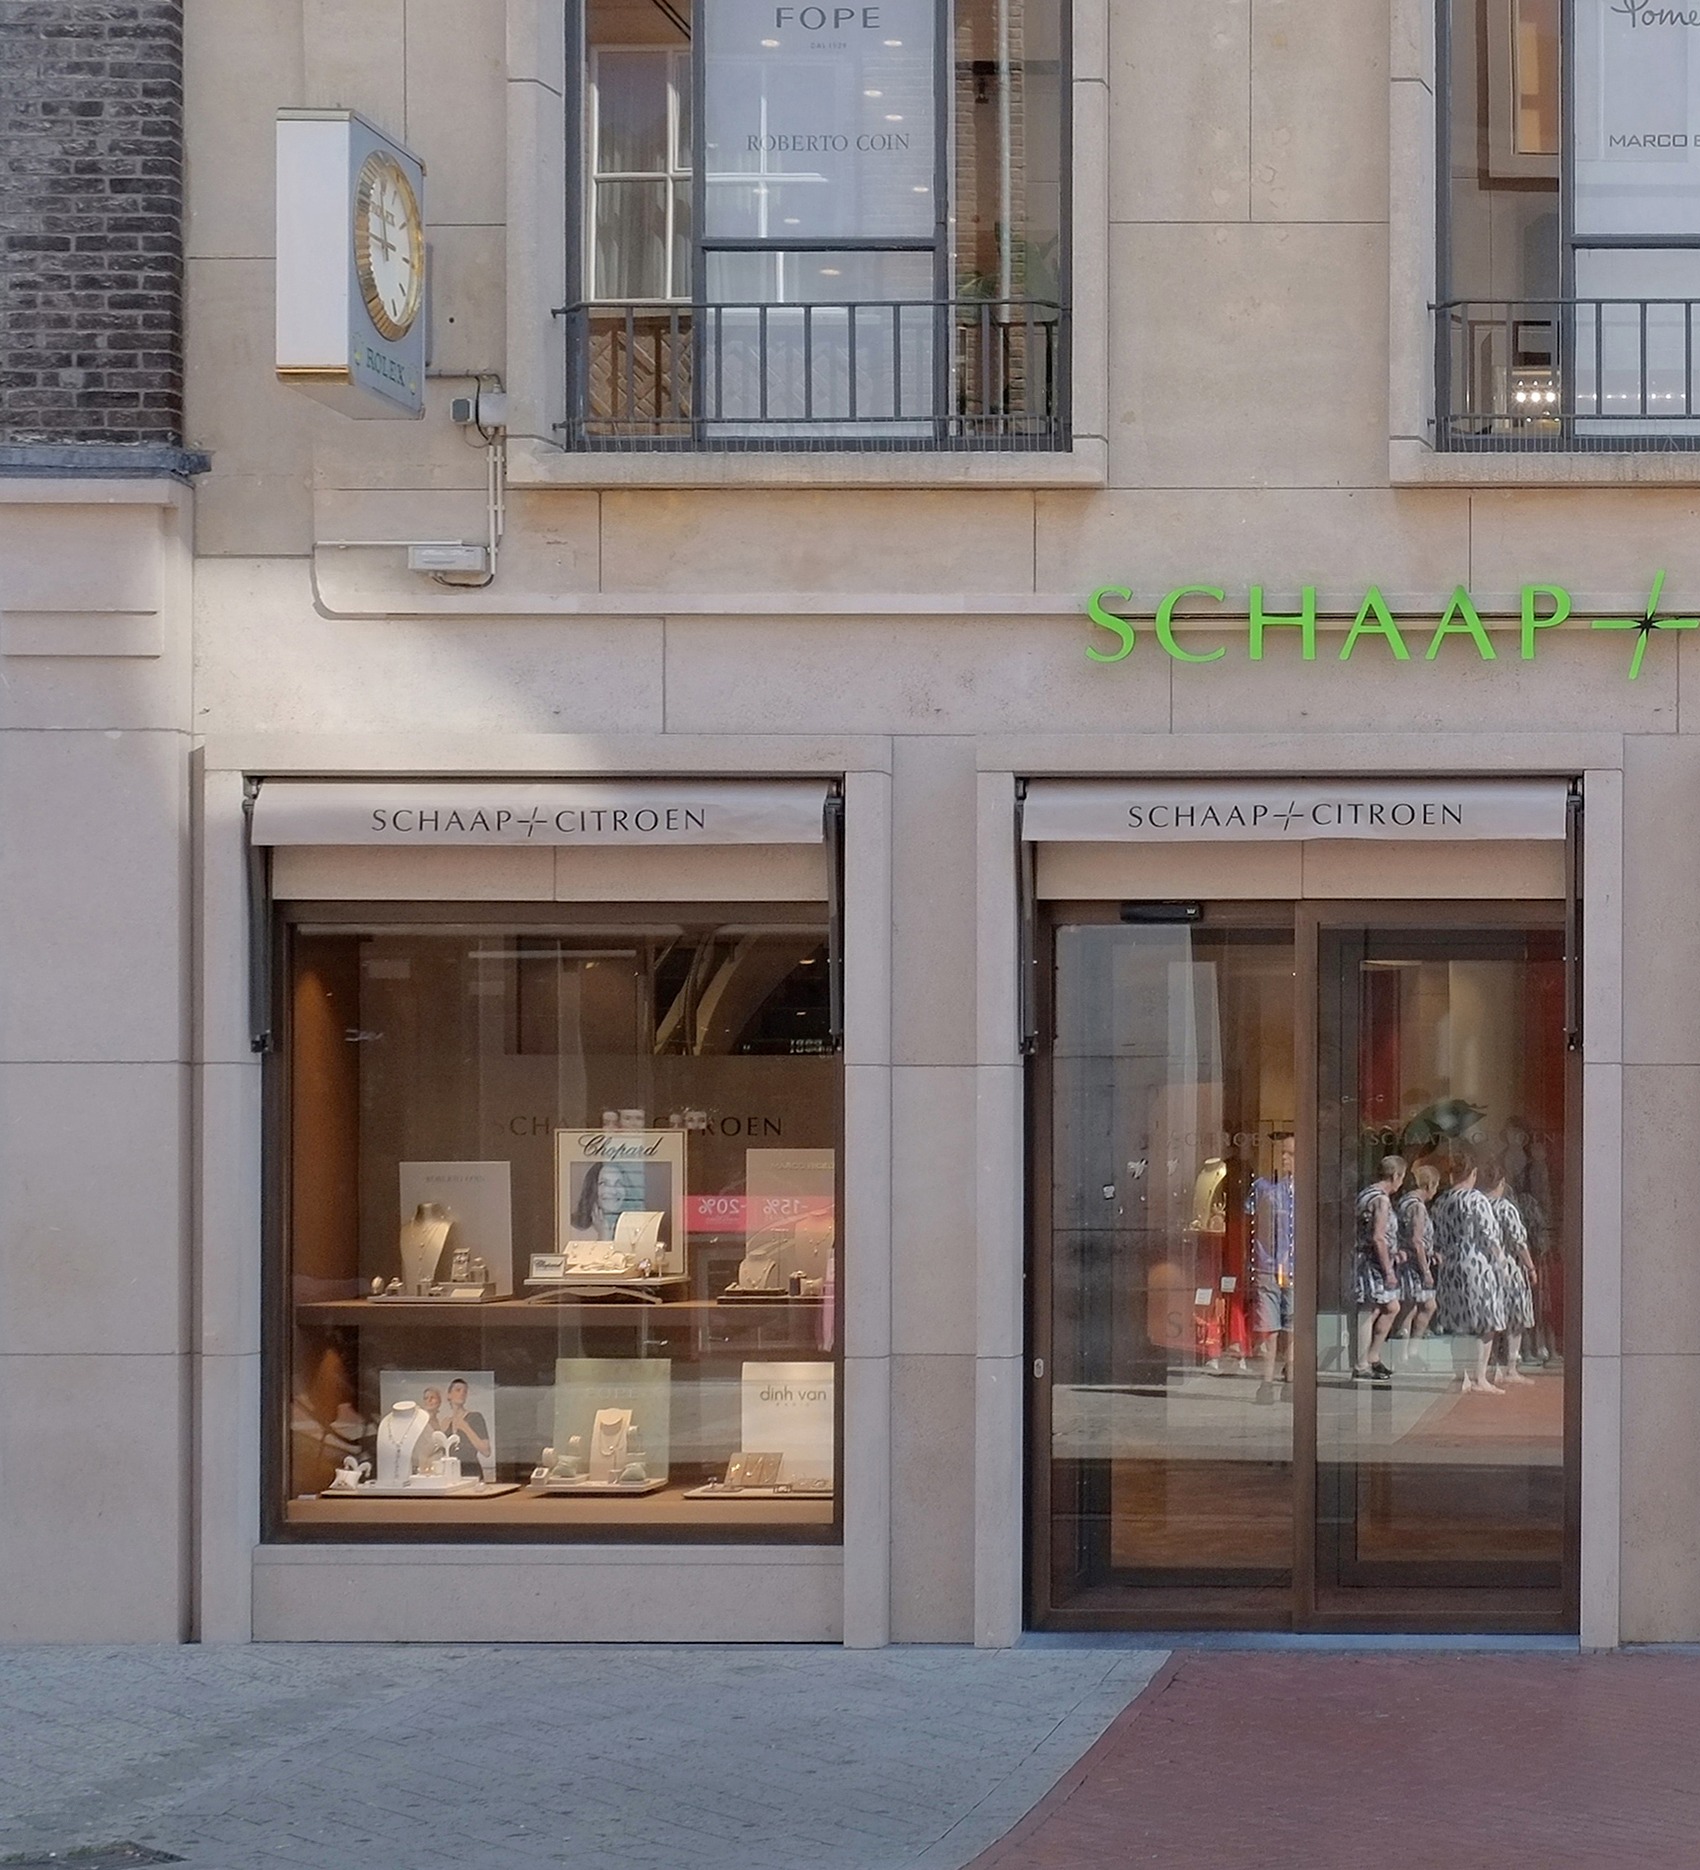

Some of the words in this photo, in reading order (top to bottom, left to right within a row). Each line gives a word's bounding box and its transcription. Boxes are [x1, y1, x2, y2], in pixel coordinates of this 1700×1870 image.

[775, 6, 881, 30] FOPE
[747, 134, 848, 151] ROBERTO
[856, 133, 910, 150] COIN
[1609, 134, 1688, 147] MARCO
[366, 347, 405, 387] ROLEX
[1085, 584, 1572, 662] SCHAAP
[371, 809, 512, 832] SCHAAP
[555, 808, 706, 832] CITROEN
[1128, 805, 1268, 828] SCHAAP
[1312, 803, 1462, 826] CITROEN
[578, 1134, 664, 1160] Chopard
[760, 1384, 793, 1401] dinh
[798, 1390, 827, 1401] van
